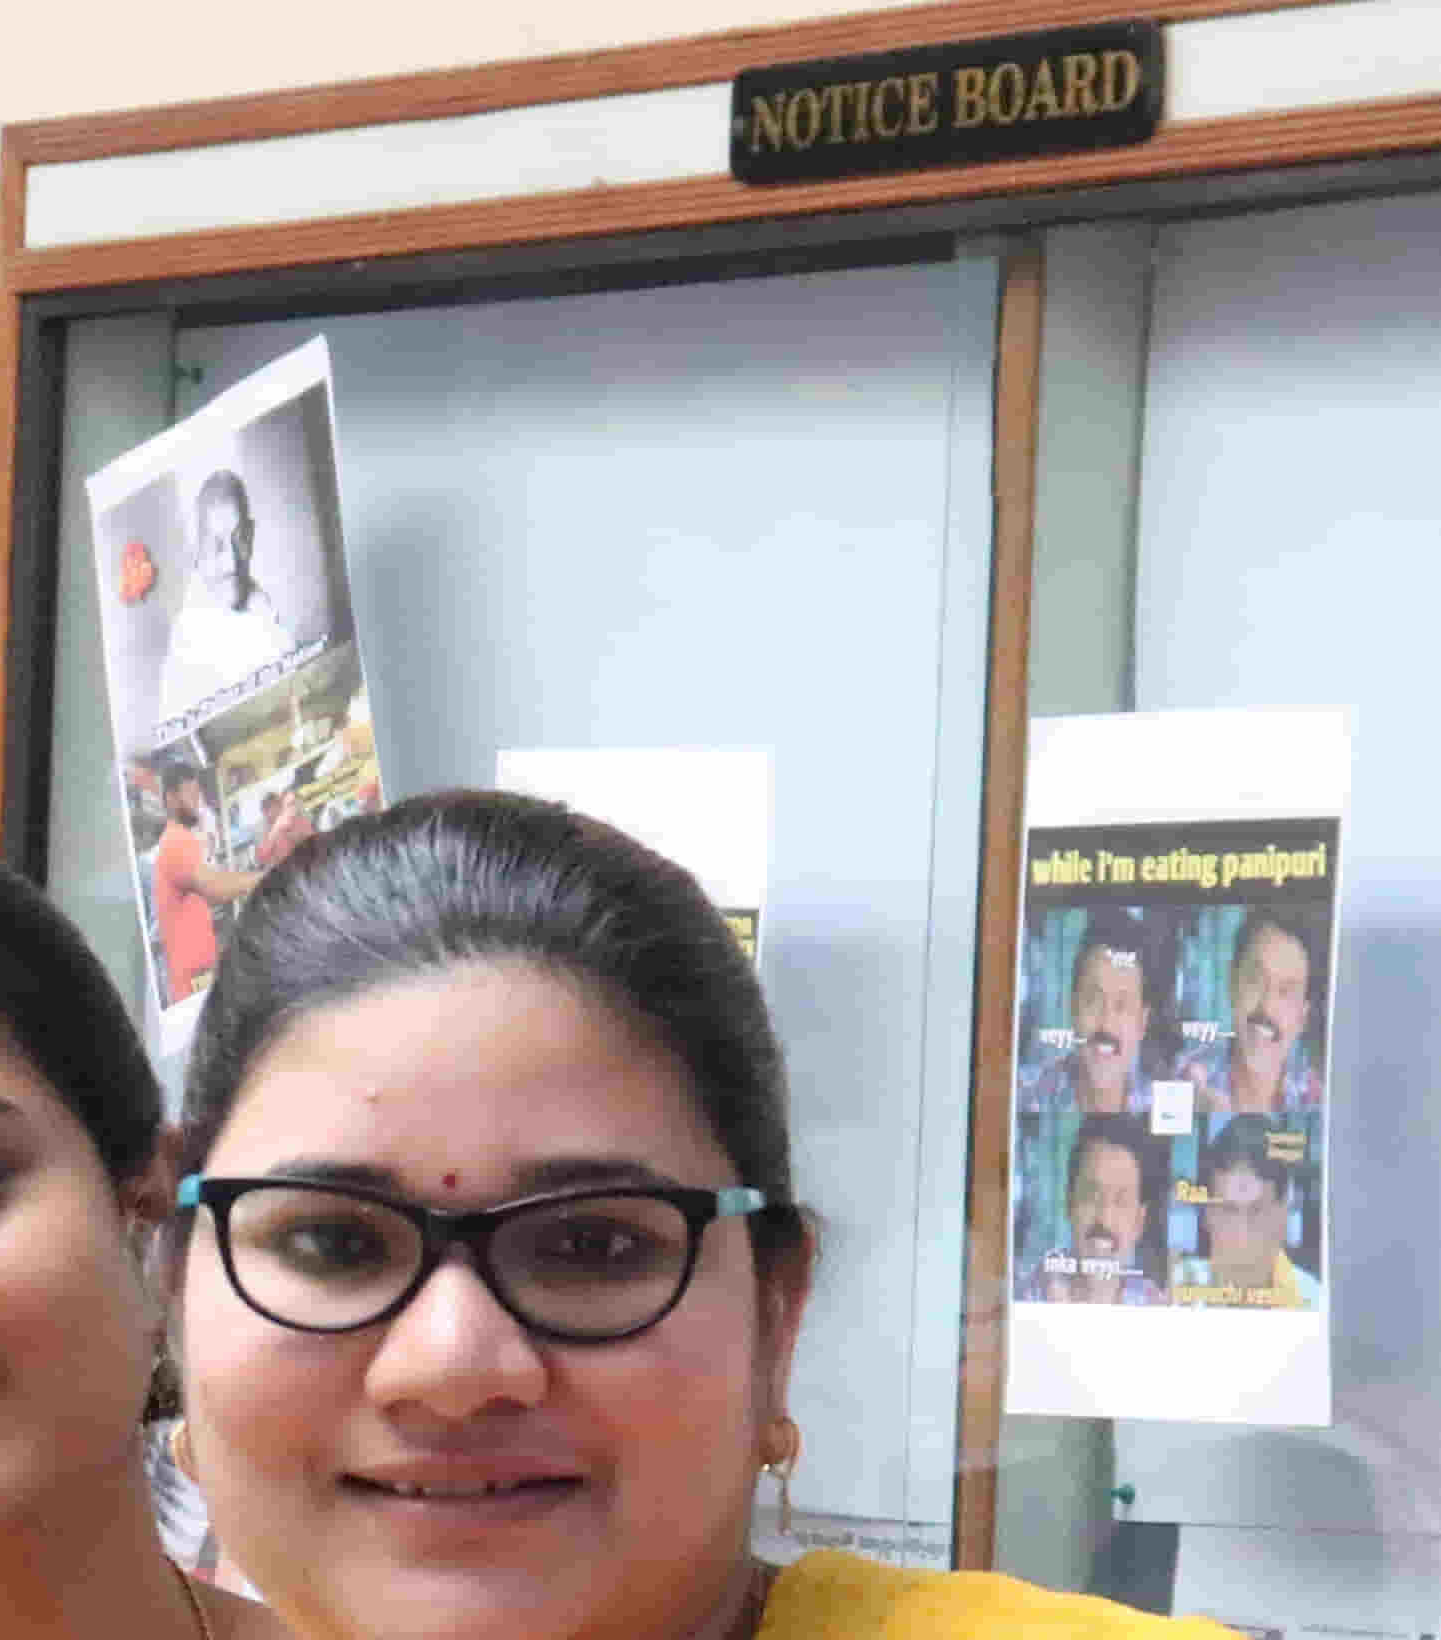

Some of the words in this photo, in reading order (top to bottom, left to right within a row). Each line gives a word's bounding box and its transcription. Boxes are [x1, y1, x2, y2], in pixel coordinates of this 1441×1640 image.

[750, 72, 939, 153] NOTICE
[952, 50, 1140, 129] BOARD
[1031, 849, 1093, 886] while
[1140, 846, 1218, 888] eating
[1221, 841, 1327, 889] panipuri
